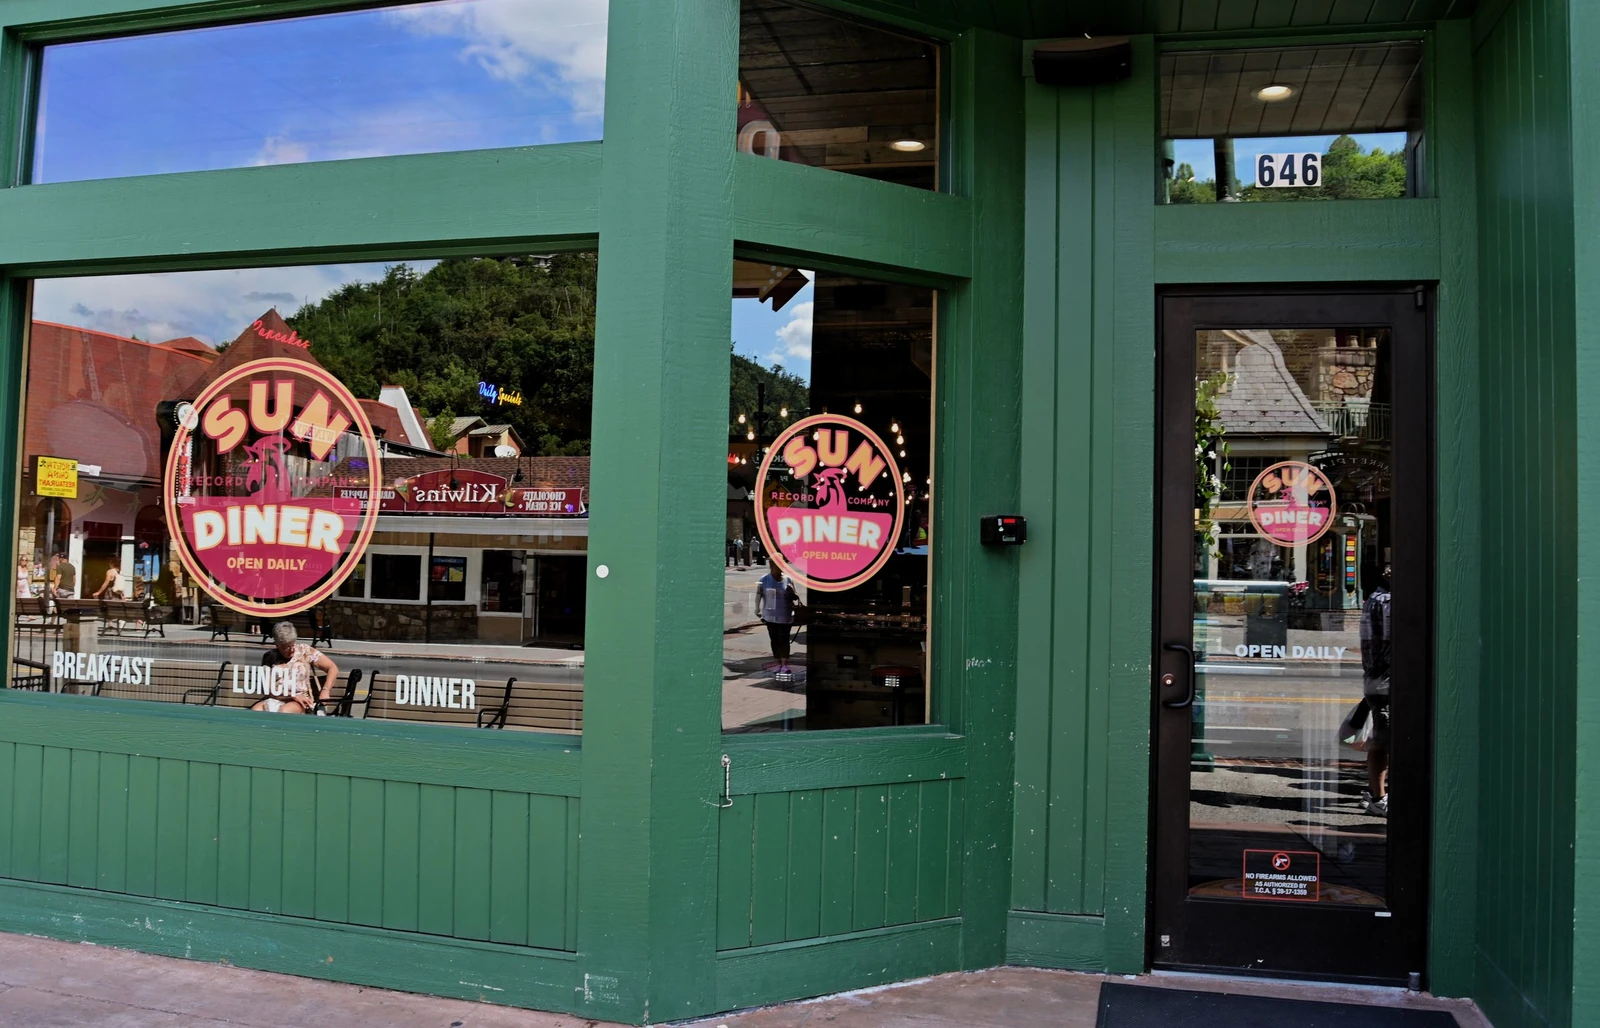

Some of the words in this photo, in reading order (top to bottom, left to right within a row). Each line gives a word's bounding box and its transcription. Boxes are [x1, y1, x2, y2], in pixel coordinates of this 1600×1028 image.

[1258, 153, 1319, 186] 646
[478, 381, 498, 404] Daily
[497, 387, 522, 406] Specials
[203, 381, 351, 460] SUN
[783, 428, 886, 489] SUN
[188, 475, 243, 488] RECORD
[1262, 467, 1325, 497] SUN
[771, 491, 814, 503] RECORD
[847, 496, 890, 507] COMPANY
[193, 506, 344, 553] DINER
[776, 516, 882, 549] DINER
[1260, 510, 1322, 527] DINER
[226, 557, 264, 571] OPEN
[267, 558, 307, 572] DAILY
[802, 550, 829, 561] OPEN
[830, 551, 857, 562] DAILY
[1235, 643, 1287, 659] OPEN
[1291, 645, 1346, 660] DAILY
[52, 650, 154, 686] BREAKFAST
[233, 664, 297, 698] LUNCH
[395, 674, 476, 710] DINNER
[1255, 873, 1287, 881] FIREARMS
[1287, 874, 1317, 882] ALLOWED
